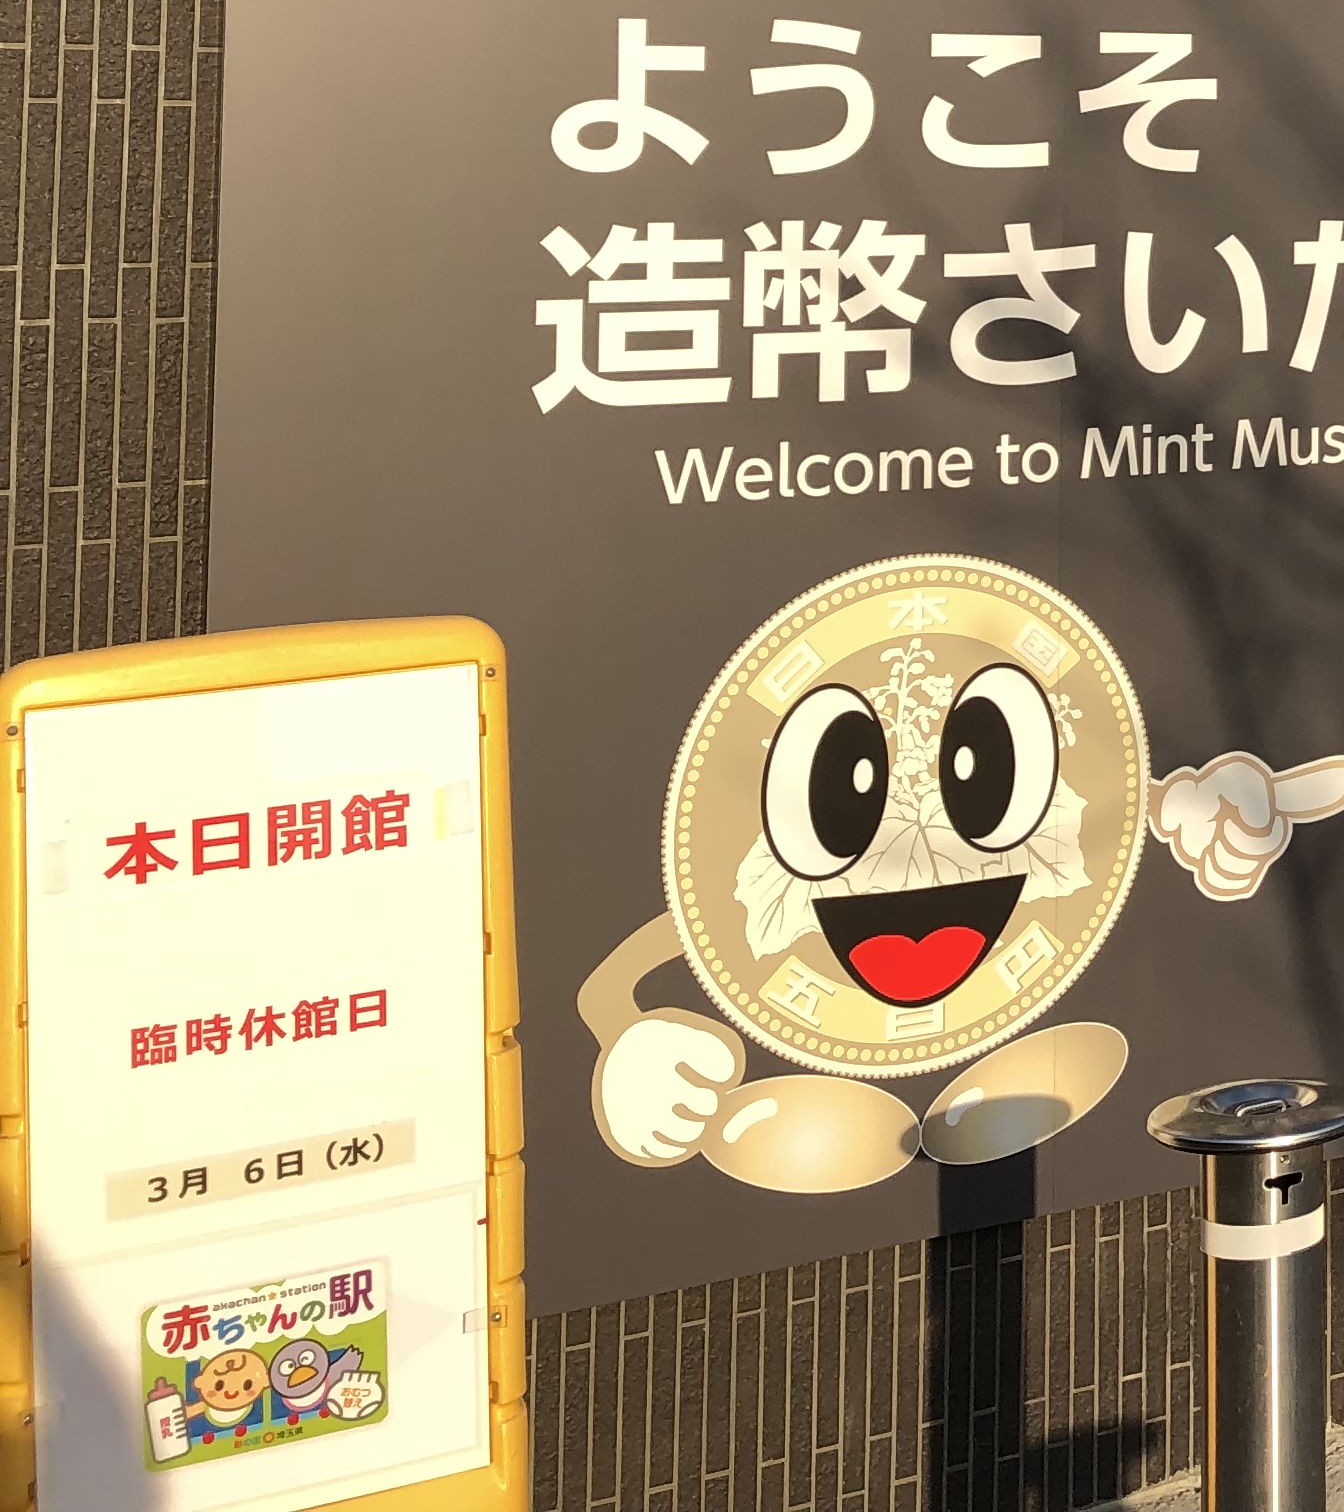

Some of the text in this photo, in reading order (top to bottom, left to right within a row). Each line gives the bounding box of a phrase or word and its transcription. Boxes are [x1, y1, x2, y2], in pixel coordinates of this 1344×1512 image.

[551, 18, 1217, 174] ようこそ
[655, 441, 973, 504] Welcome
[996, 434, 1058, 485] to
[1080, 423, 1213, 480] Mint
[103, 790, 410, 885] 本日開館
[131, 989, 388, 1069] 臨時休館日
[162, 1269, 375, 1354] 赤ちゃんの駅
[212, 1282, 327, 1311] akachan station
